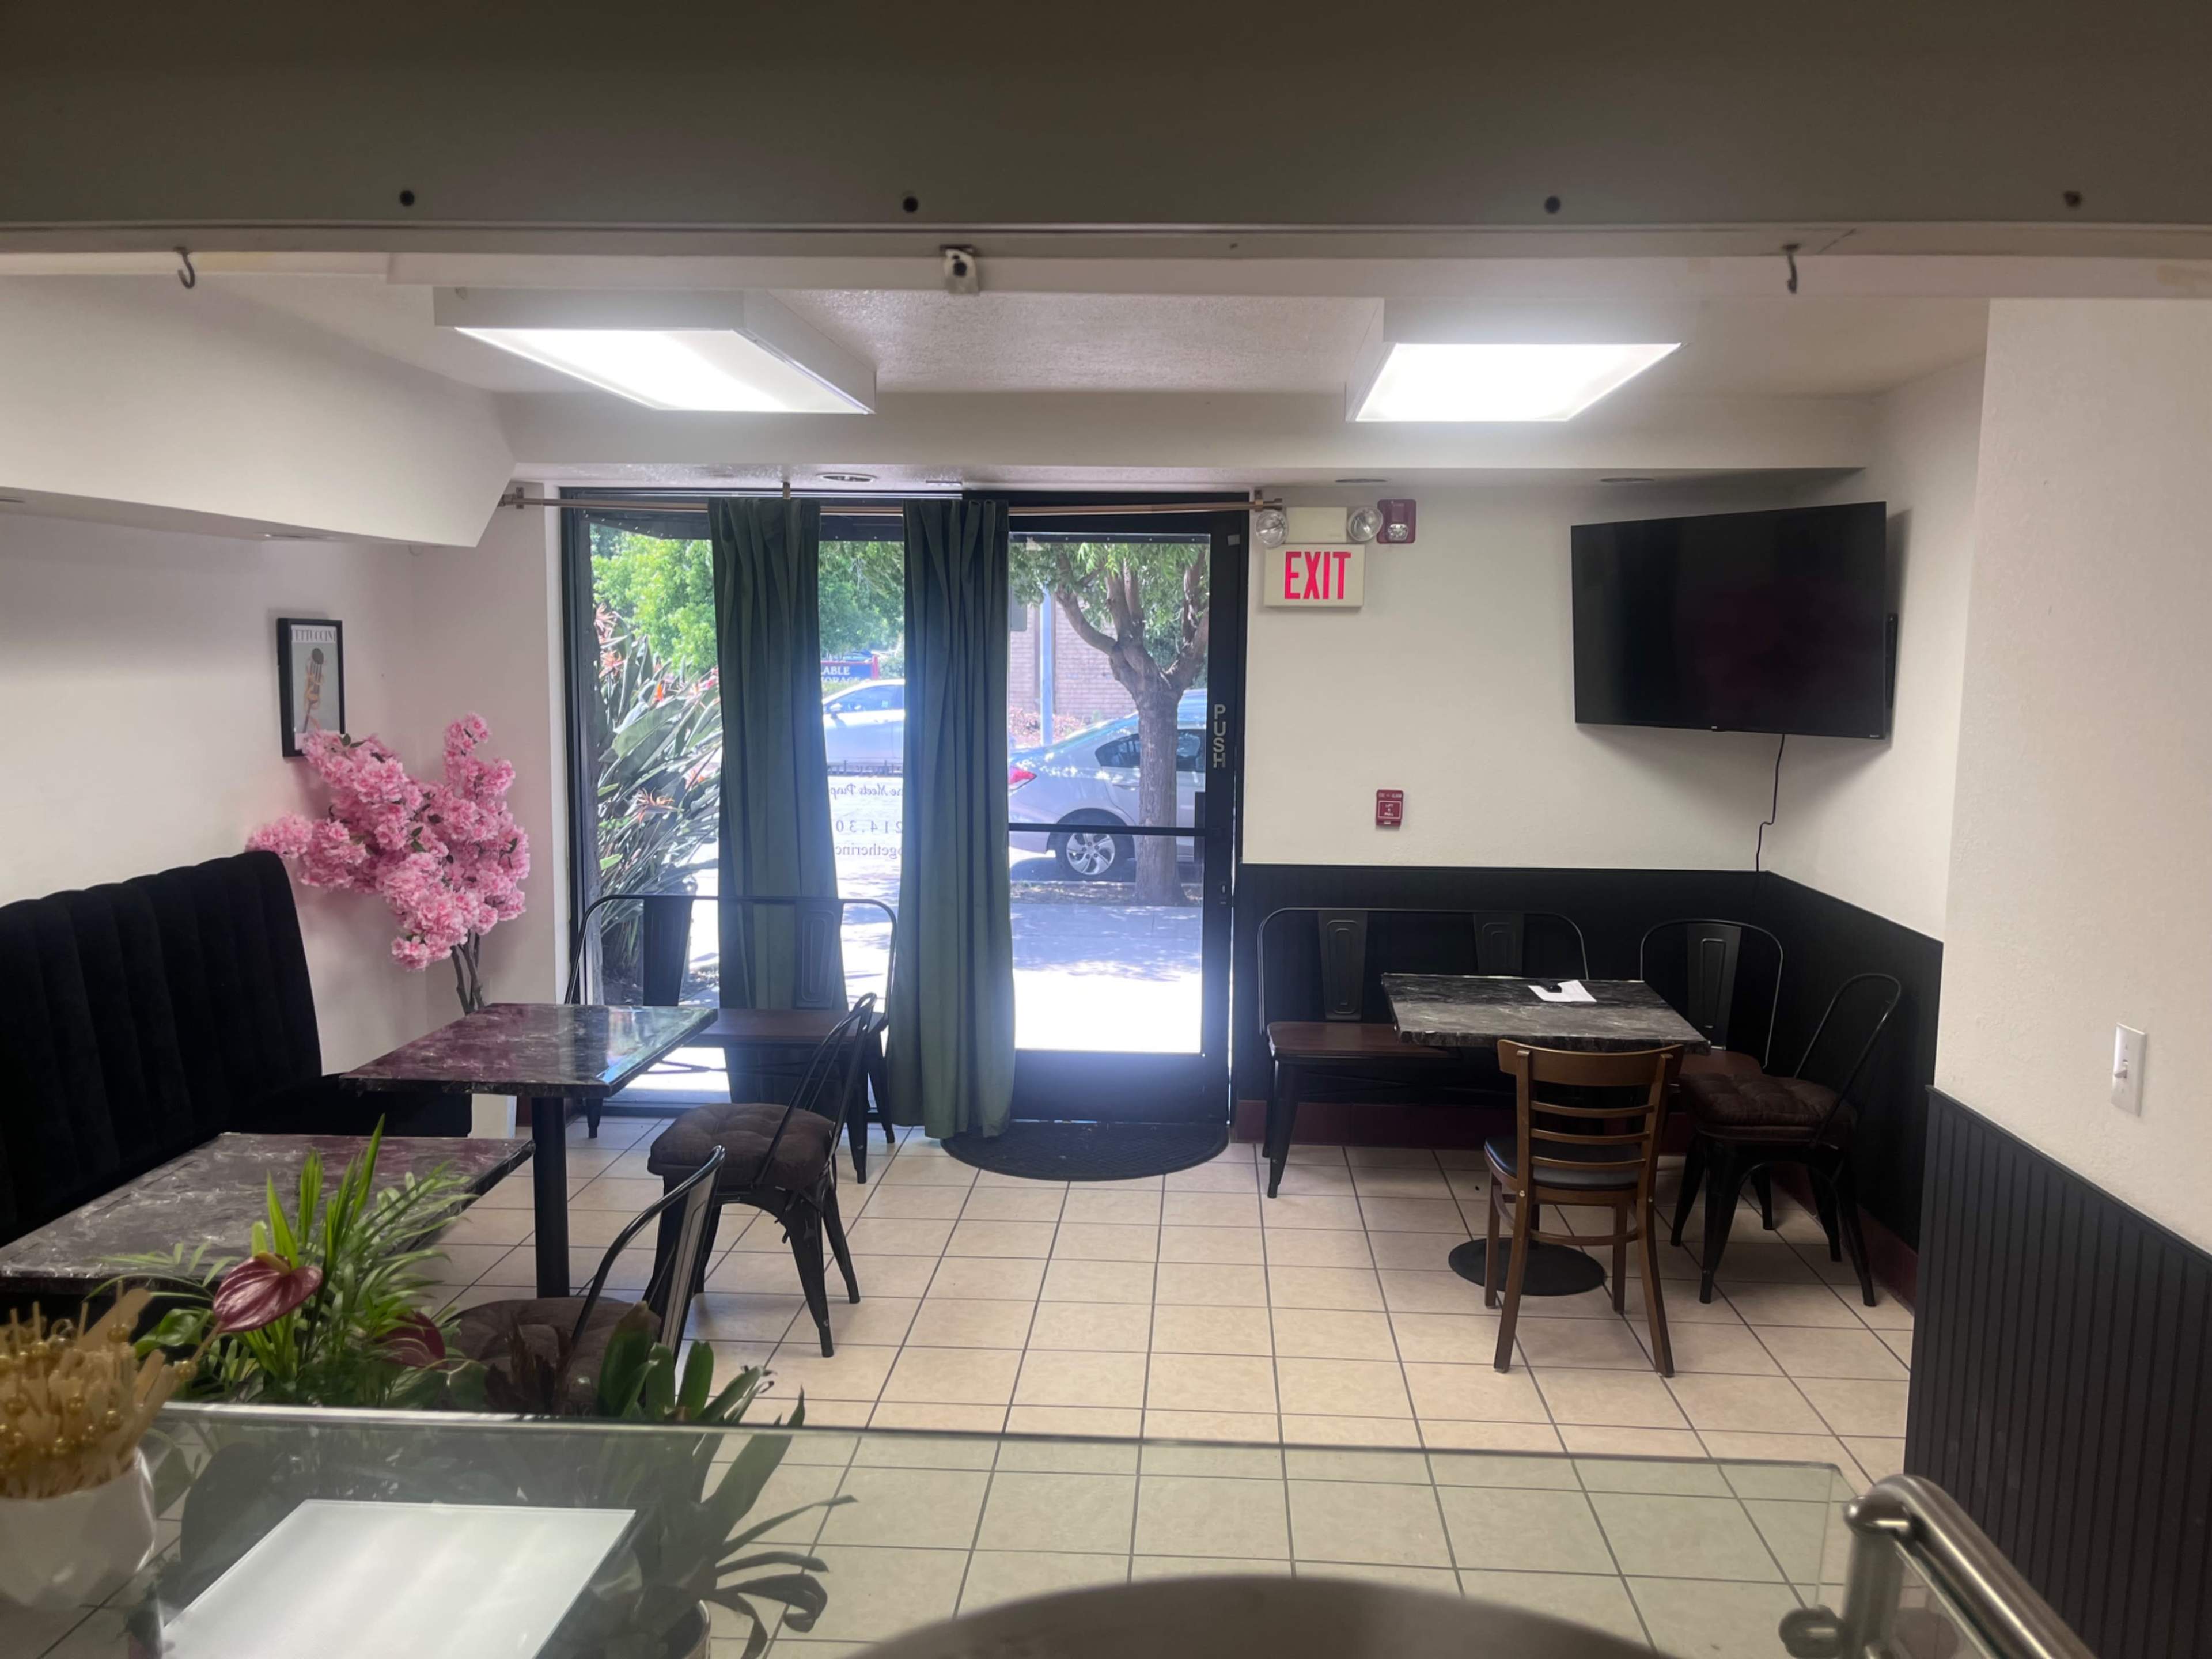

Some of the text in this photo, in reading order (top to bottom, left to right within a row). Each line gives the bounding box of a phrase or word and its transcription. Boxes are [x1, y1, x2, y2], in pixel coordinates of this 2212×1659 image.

[1284, 551, 1351, 600] EXIT
[821, 666, 850, 675] ABLE
[1213, 704, 1226, 768] PUSH
